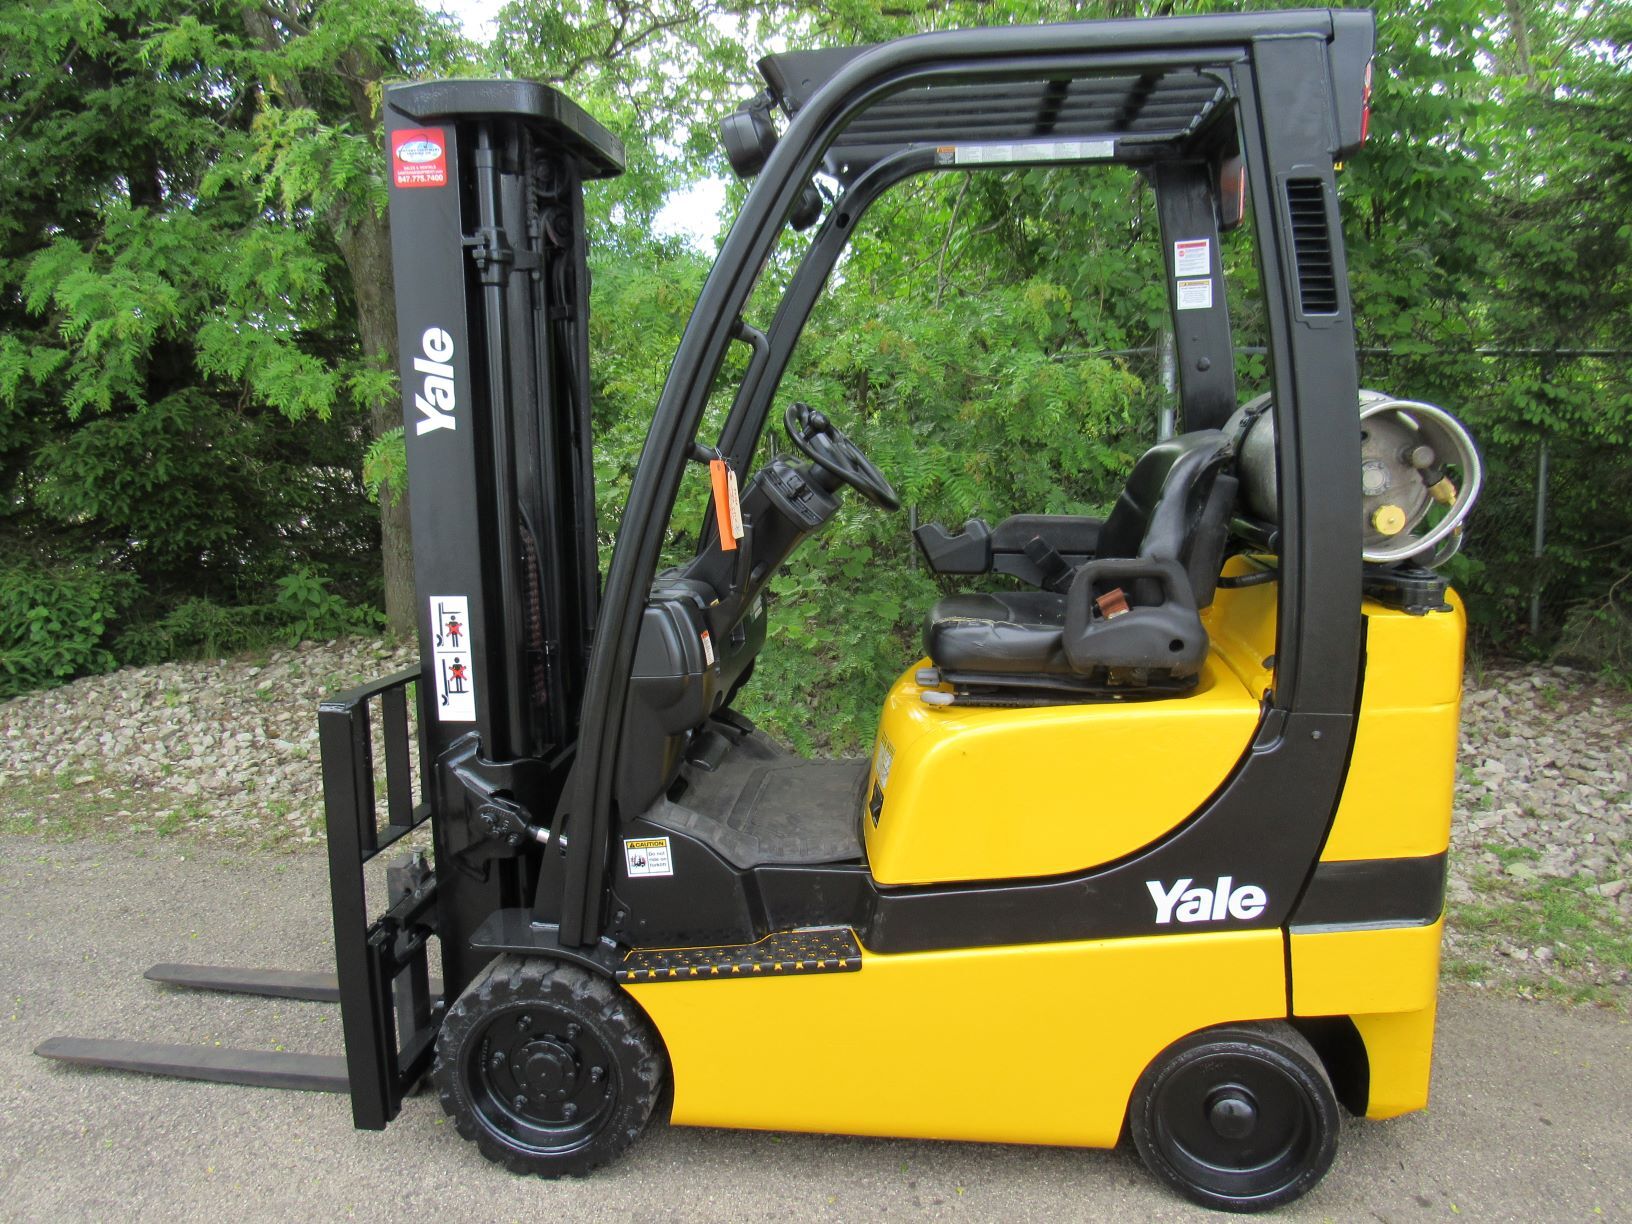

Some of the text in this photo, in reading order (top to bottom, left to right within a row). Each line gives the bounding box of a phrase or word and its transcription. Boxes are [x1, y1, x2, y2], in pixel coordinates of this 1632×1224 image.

[398, 175, 443, 183] 847.775.7400
[413, 327, 456, 436] Yale
[1145, 876, 1267, 924] Yale
